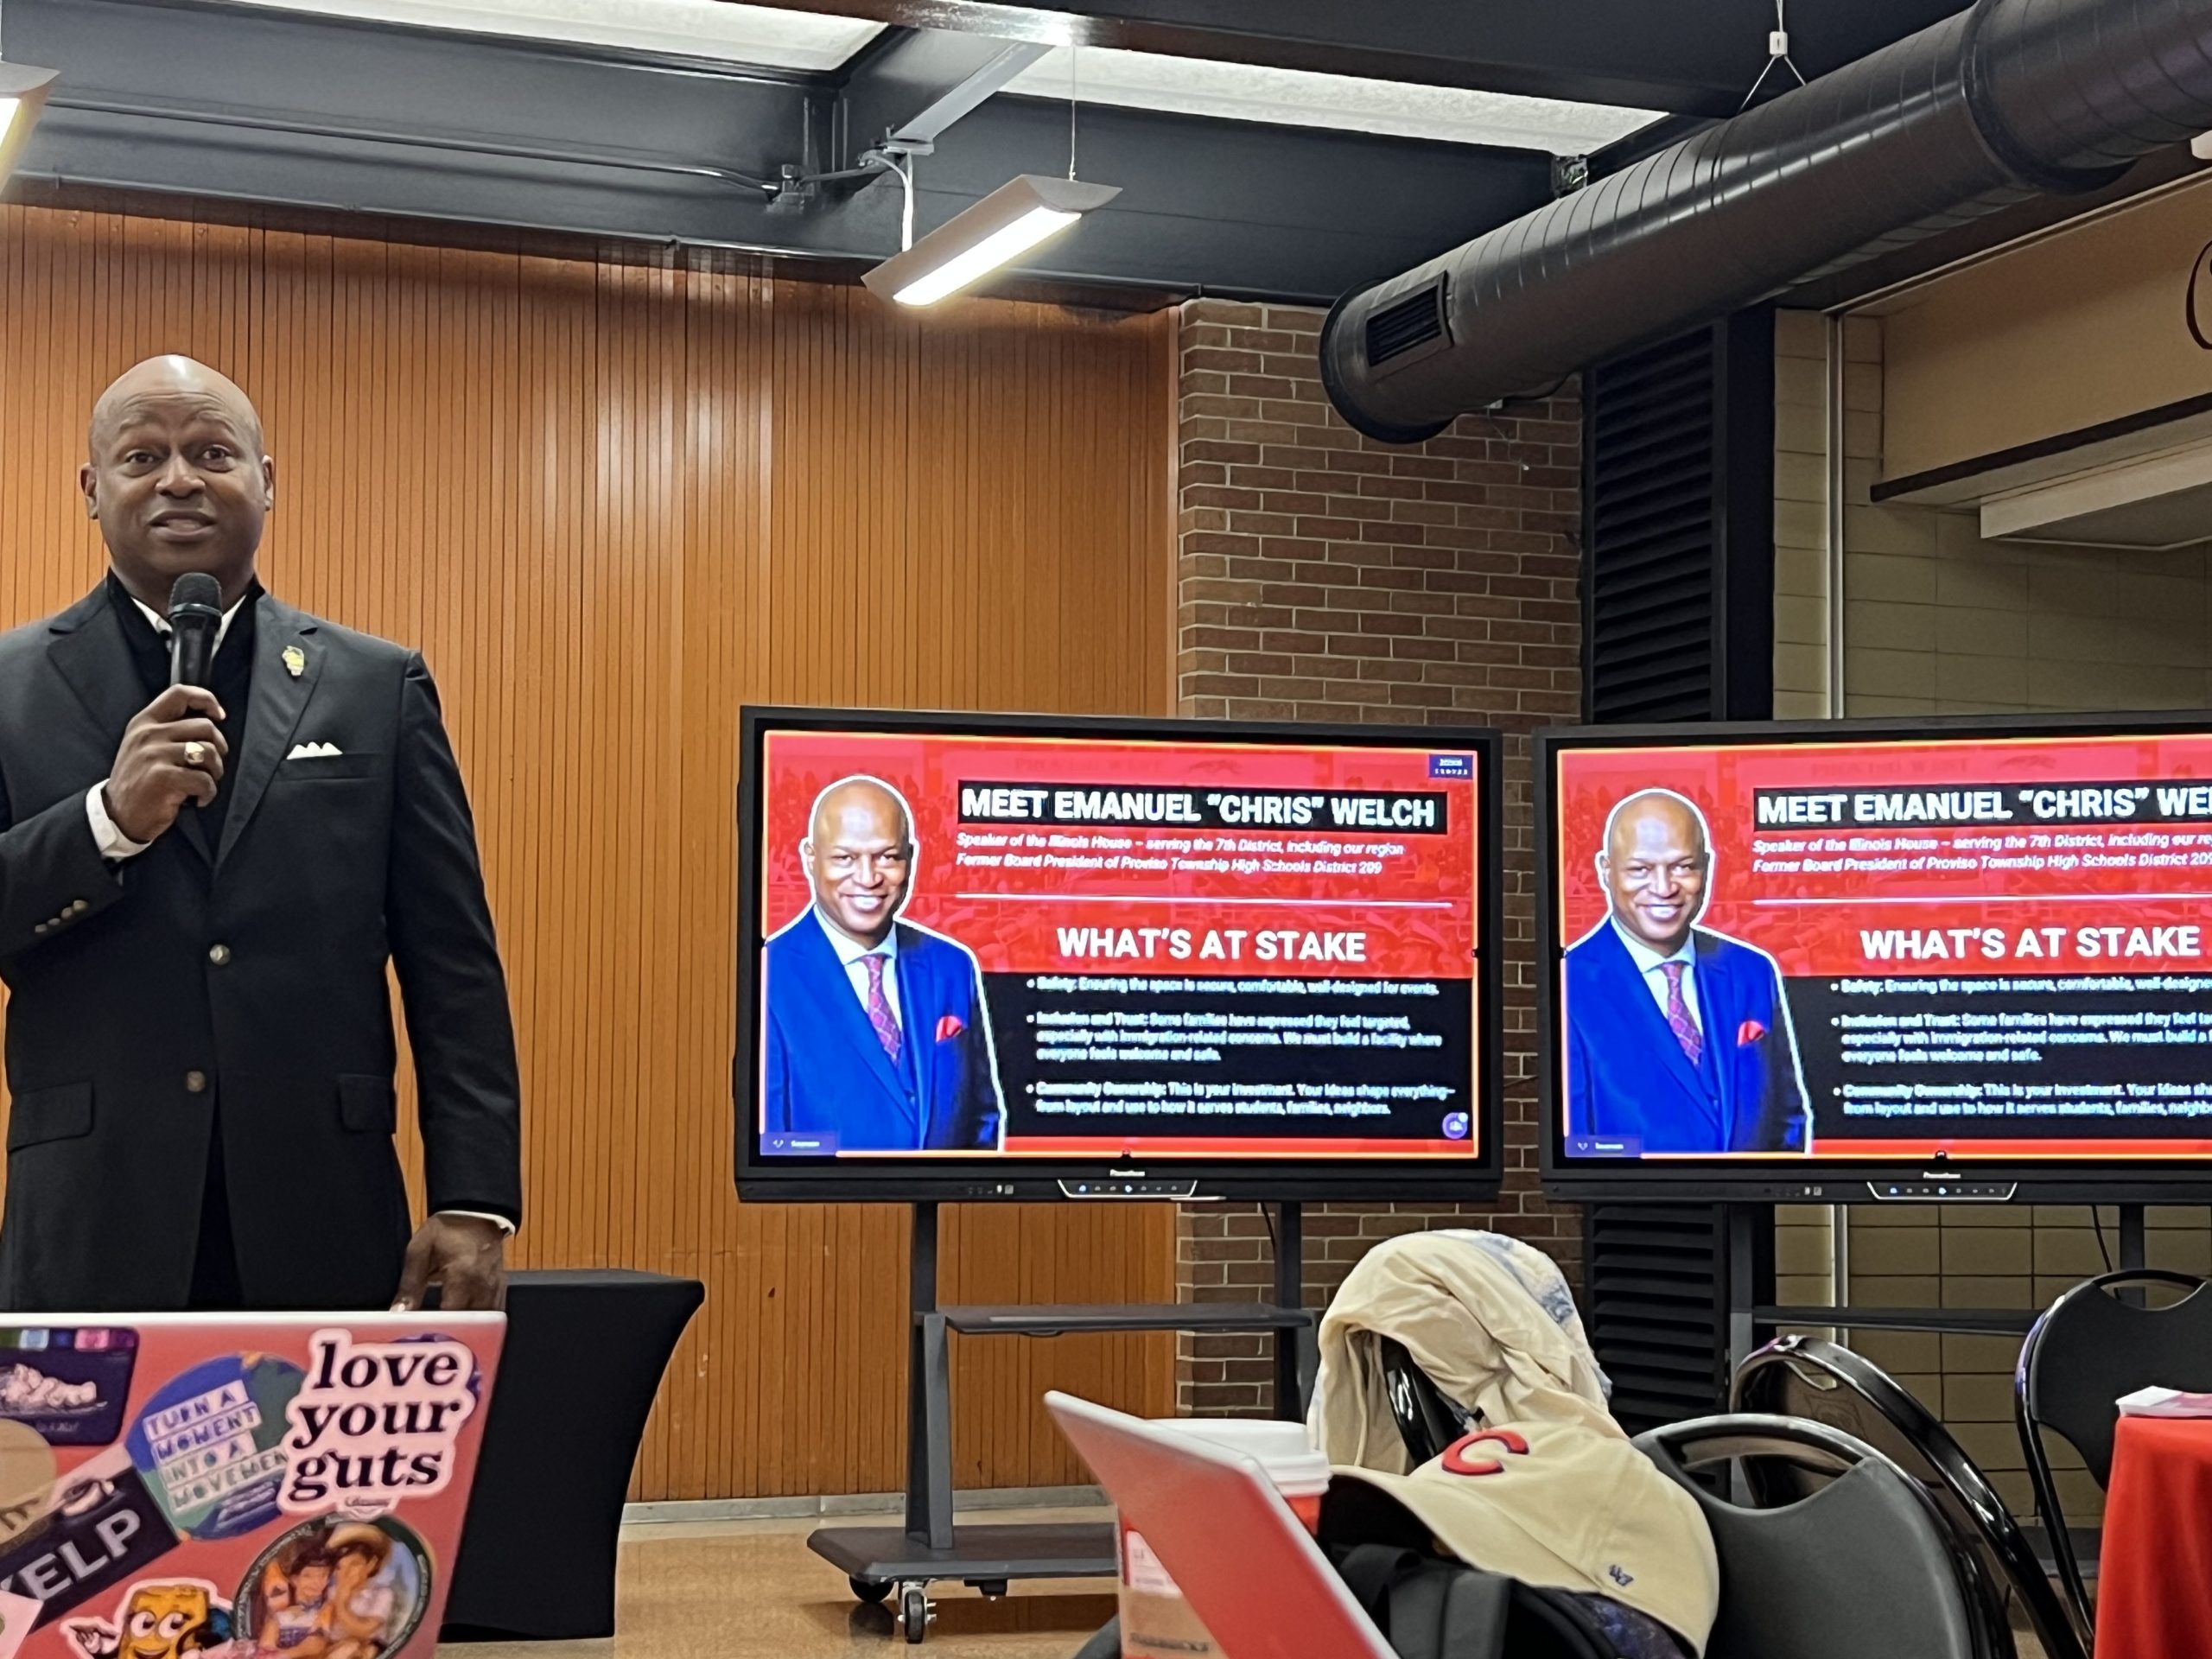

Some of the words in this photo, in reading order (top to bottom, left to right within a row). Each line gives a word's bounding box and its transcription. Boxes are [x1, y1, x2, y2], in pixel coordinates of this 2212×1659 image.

[962, 789, 1048, 817] MEET
[1053, 791, 1201, 821] EMANUEL
[1331, 798, 1434, 826] WELCH
[1758, 794, 1847, 823] MEET
[1854, 791, 2013, 821] EMANUEL
[1057, 928, 1193, 959] WHAT'S
[1198, 931, 1248, 959] AT
[1255, 931, 1366, 962] STAKE
[1859, 928, 2005, 959] WHAT'S
[2014, 928, 2067, 957] AT
[2075, 926, 2201, 957] STAKE
[312, 1342, 458, 1389] love
[220, 1389, 236, 1408] A
[156, 1405, 257, 1460] MOMENT
[292, 1401, 461, 1449] your
[288, 1446, 444, 1502] guts
[1441, 1429, 1529, 1476] C
[174, 1450, 289, 1509] MOVEMEN
[0, 1509, 141, 1601] ELP
